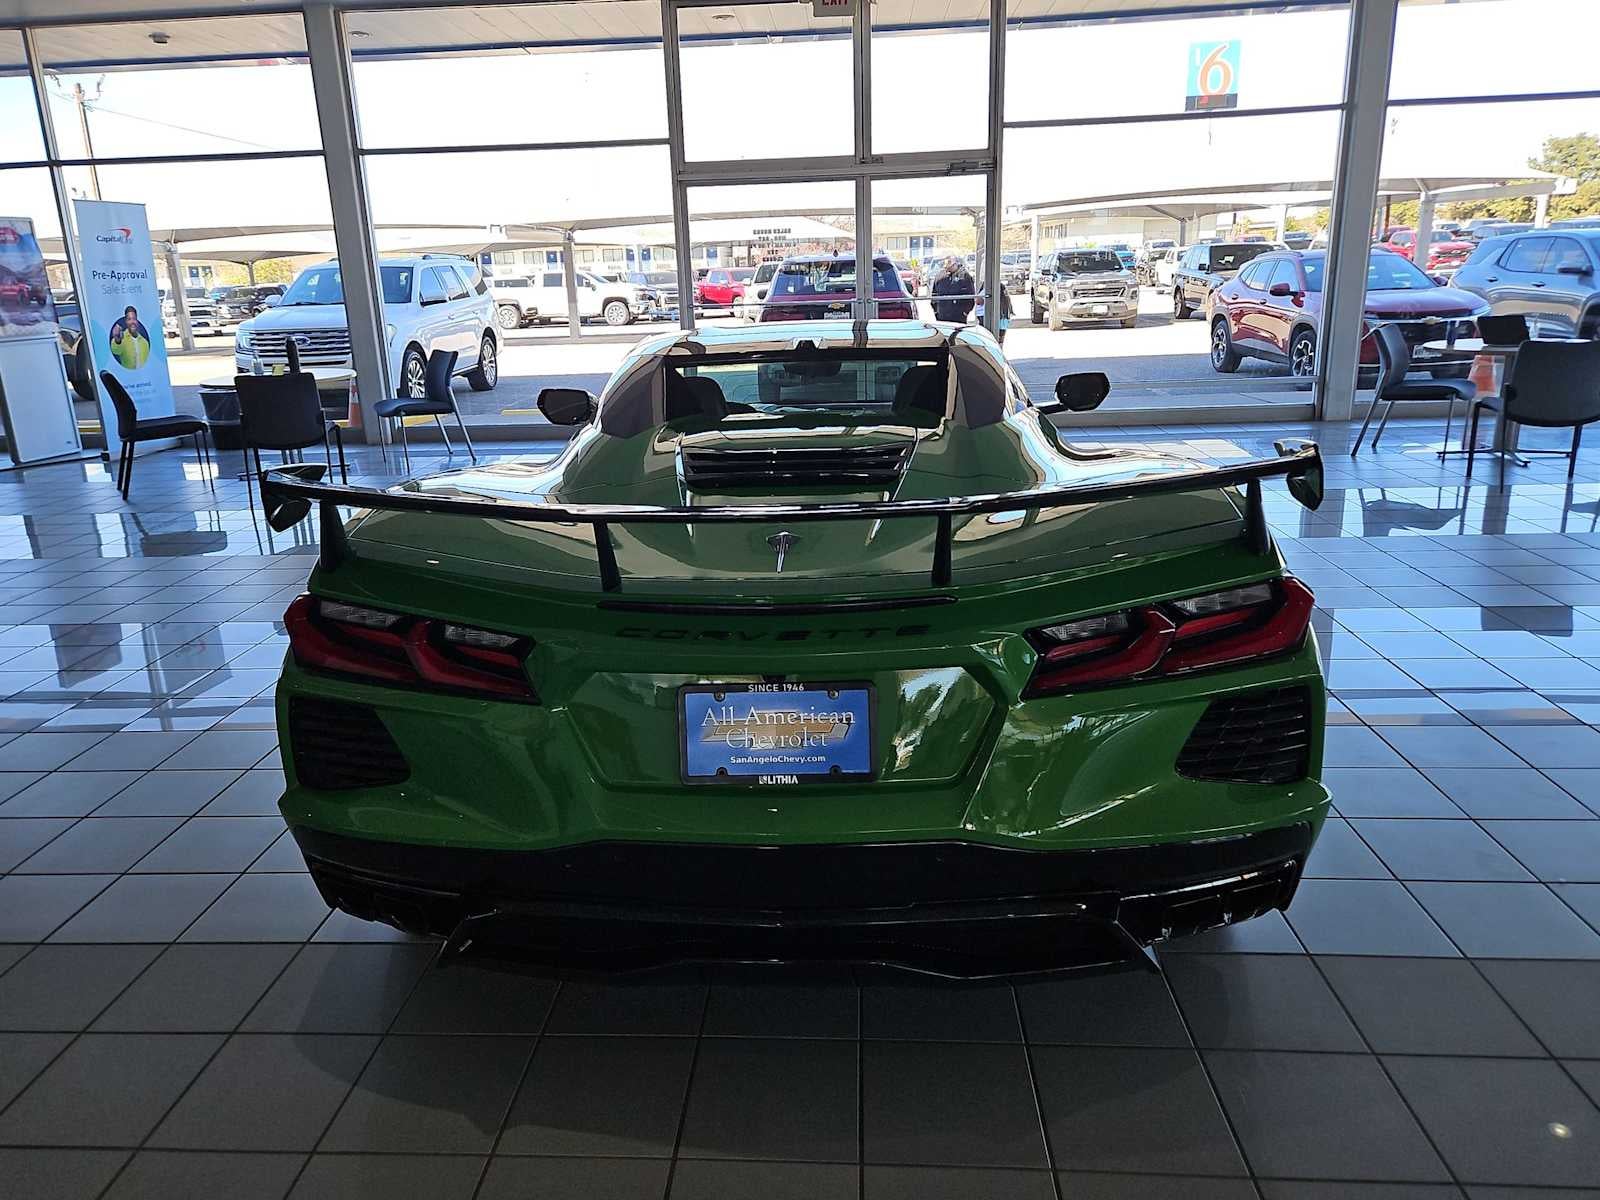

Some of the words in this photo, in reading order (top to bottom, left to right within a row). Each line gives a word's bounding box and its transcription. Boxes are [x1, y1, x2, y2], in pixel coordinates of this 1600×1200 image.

[1197, 43, 1232, 96] 6
[92, 269, 147, 282] Pre-Approval
[102, 284, 120, 295] Sale
[121, 284, 142, 295] Event
[616, 624, 932, 642] CORVETTE
[748, 684, 779, 692] SINCE
[782, 684, 804, 692] 1946
[701, 705, 736, 726] All
[744, 705, 856, 726] American
[726, 727, 828, 749] Chevrolet
[730, 755, 826, 764] SanAngeloChevy.com
[768, 775, 799, 784] LITHIA
